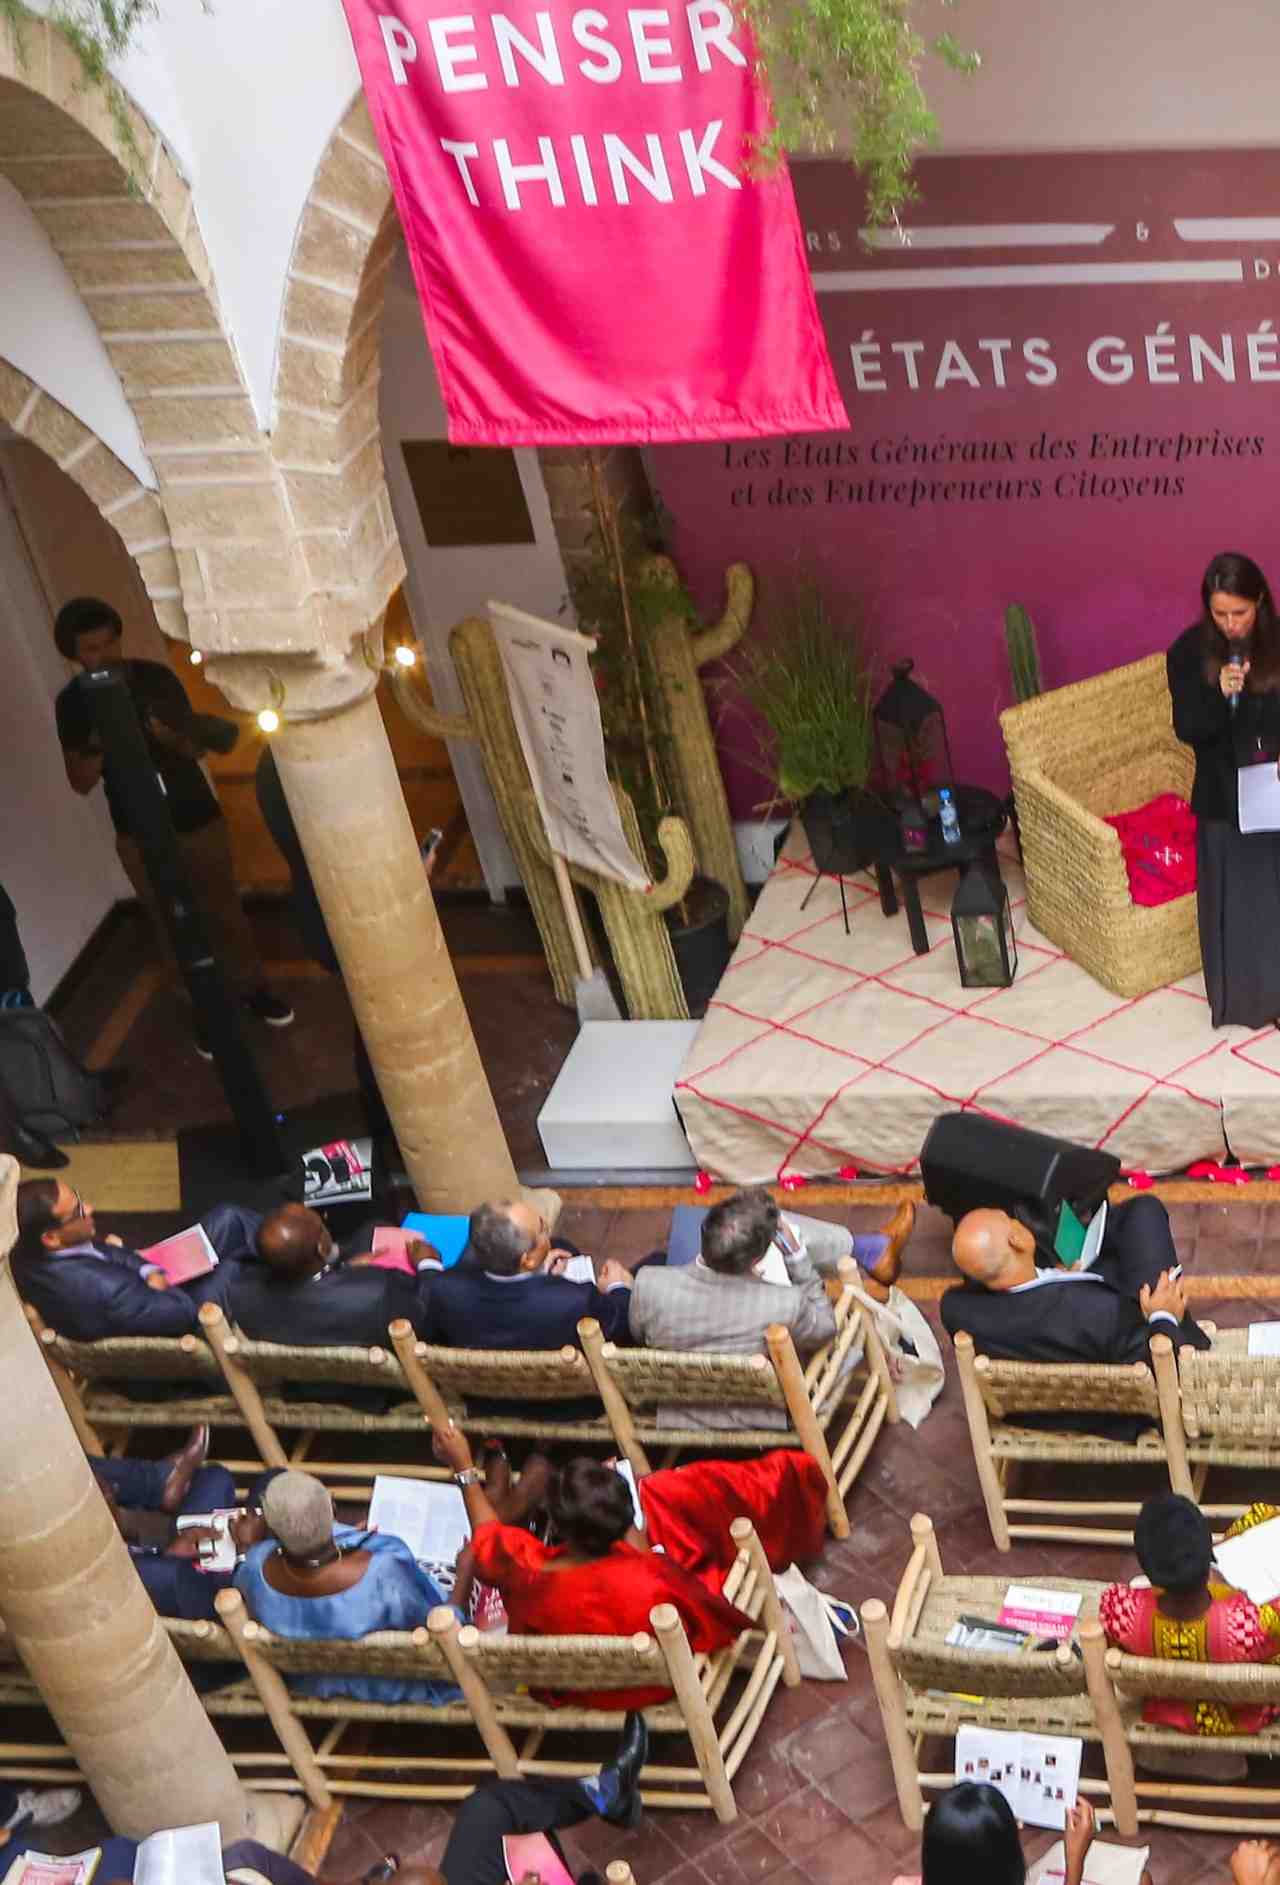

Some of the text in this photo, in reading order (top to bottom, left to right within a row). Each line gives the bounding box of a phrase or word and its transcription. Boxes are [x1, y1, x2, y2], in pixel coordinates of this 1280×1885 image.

[378, 0, 747, 94] PENSER
[440, 120, 742, 211] THINK
[850, 330, 1057, 390] ÉTATS
[722, 443, 771, 469] Les
[871, 434, 1016, 466] Généraux
[1028, 431, 1077, 461] des
[1089, 429, 1264, 462] Entreprises
[731, 470, 1185, 509] et des Entrepreneurs Citoyens
